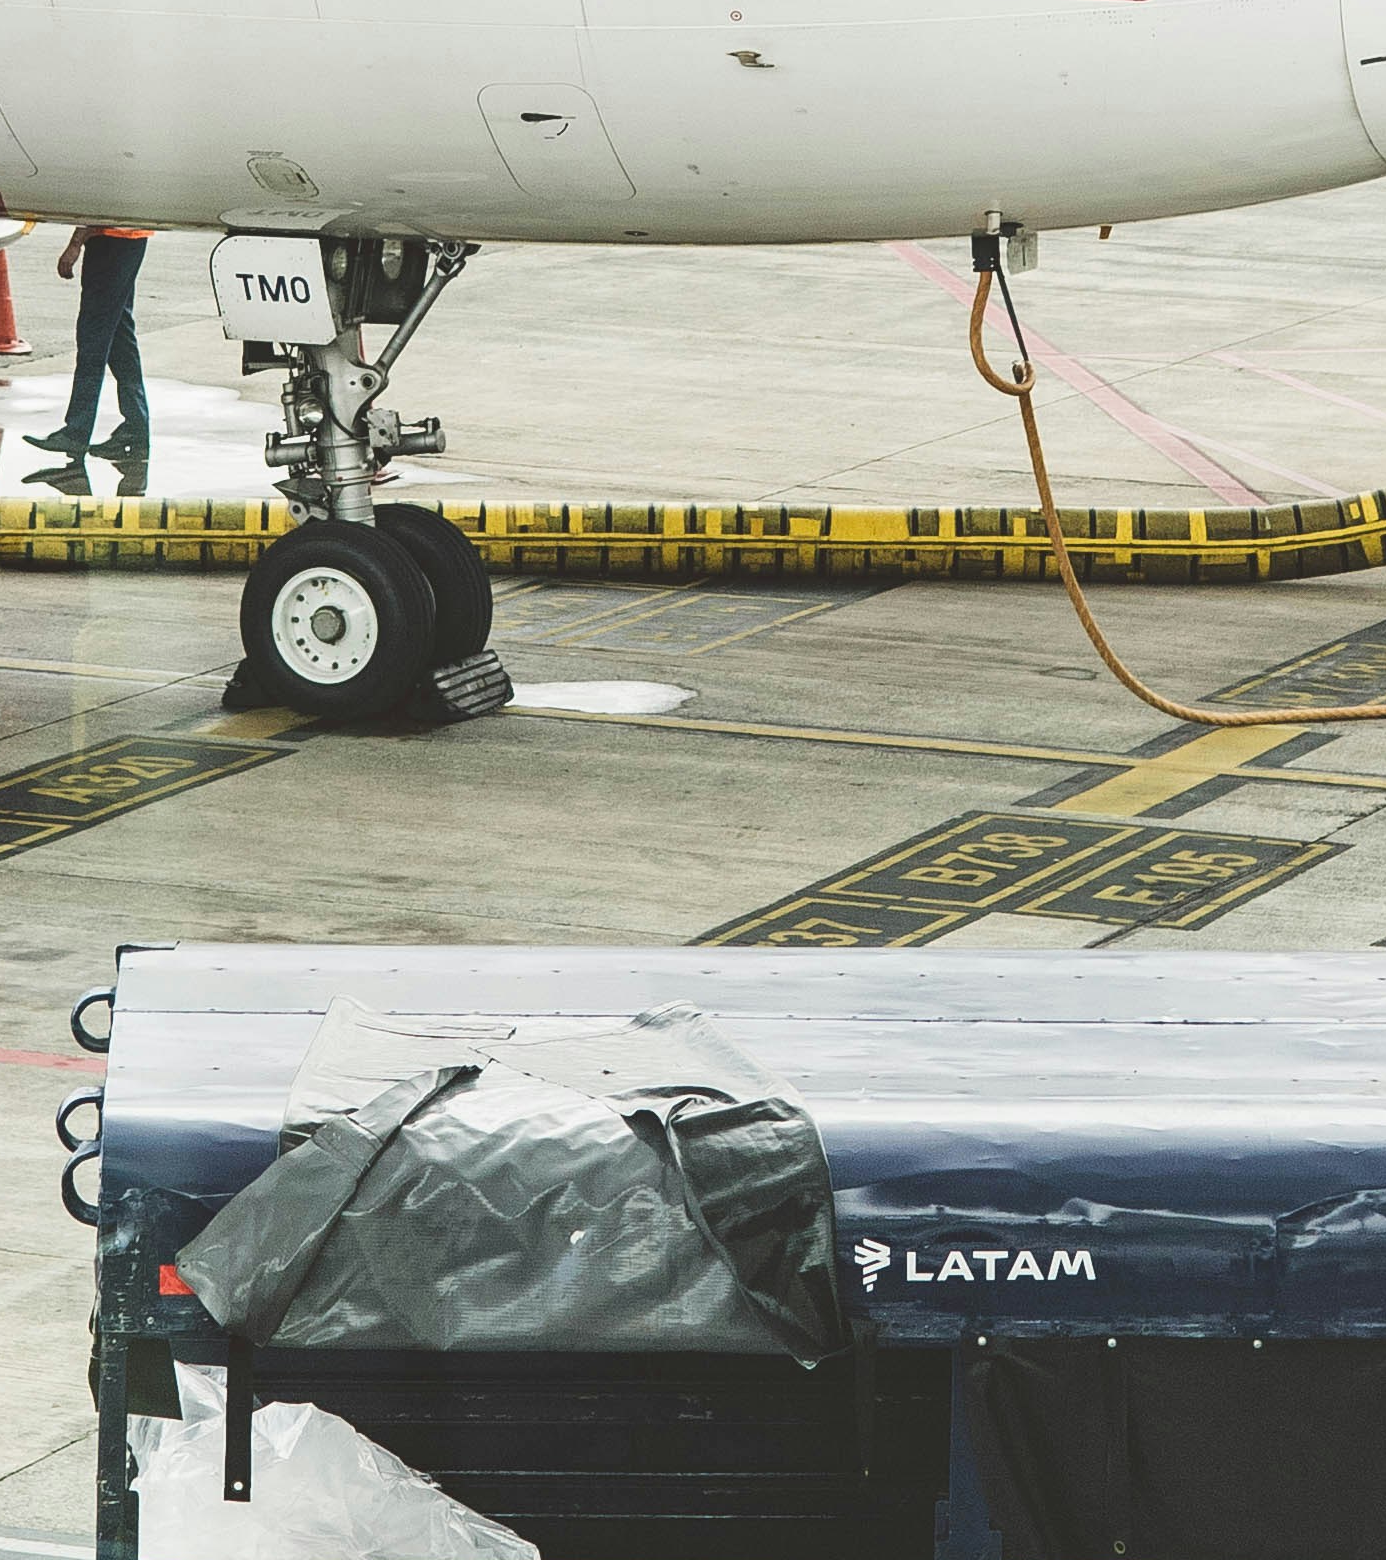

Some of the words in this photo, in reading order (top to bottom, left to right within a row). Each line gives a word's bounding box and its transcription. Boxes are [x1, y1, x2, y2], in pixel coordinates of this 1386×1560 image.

[235, 273, 311, 304] TMO
[28, 755, 195, 804] A320
[898, 832, 1069, 887] B738
[1092, 850, 1258, 906] E195
[751, 917, 884, 947] 37
[906, 1250, 1097, 1281] LATAM
